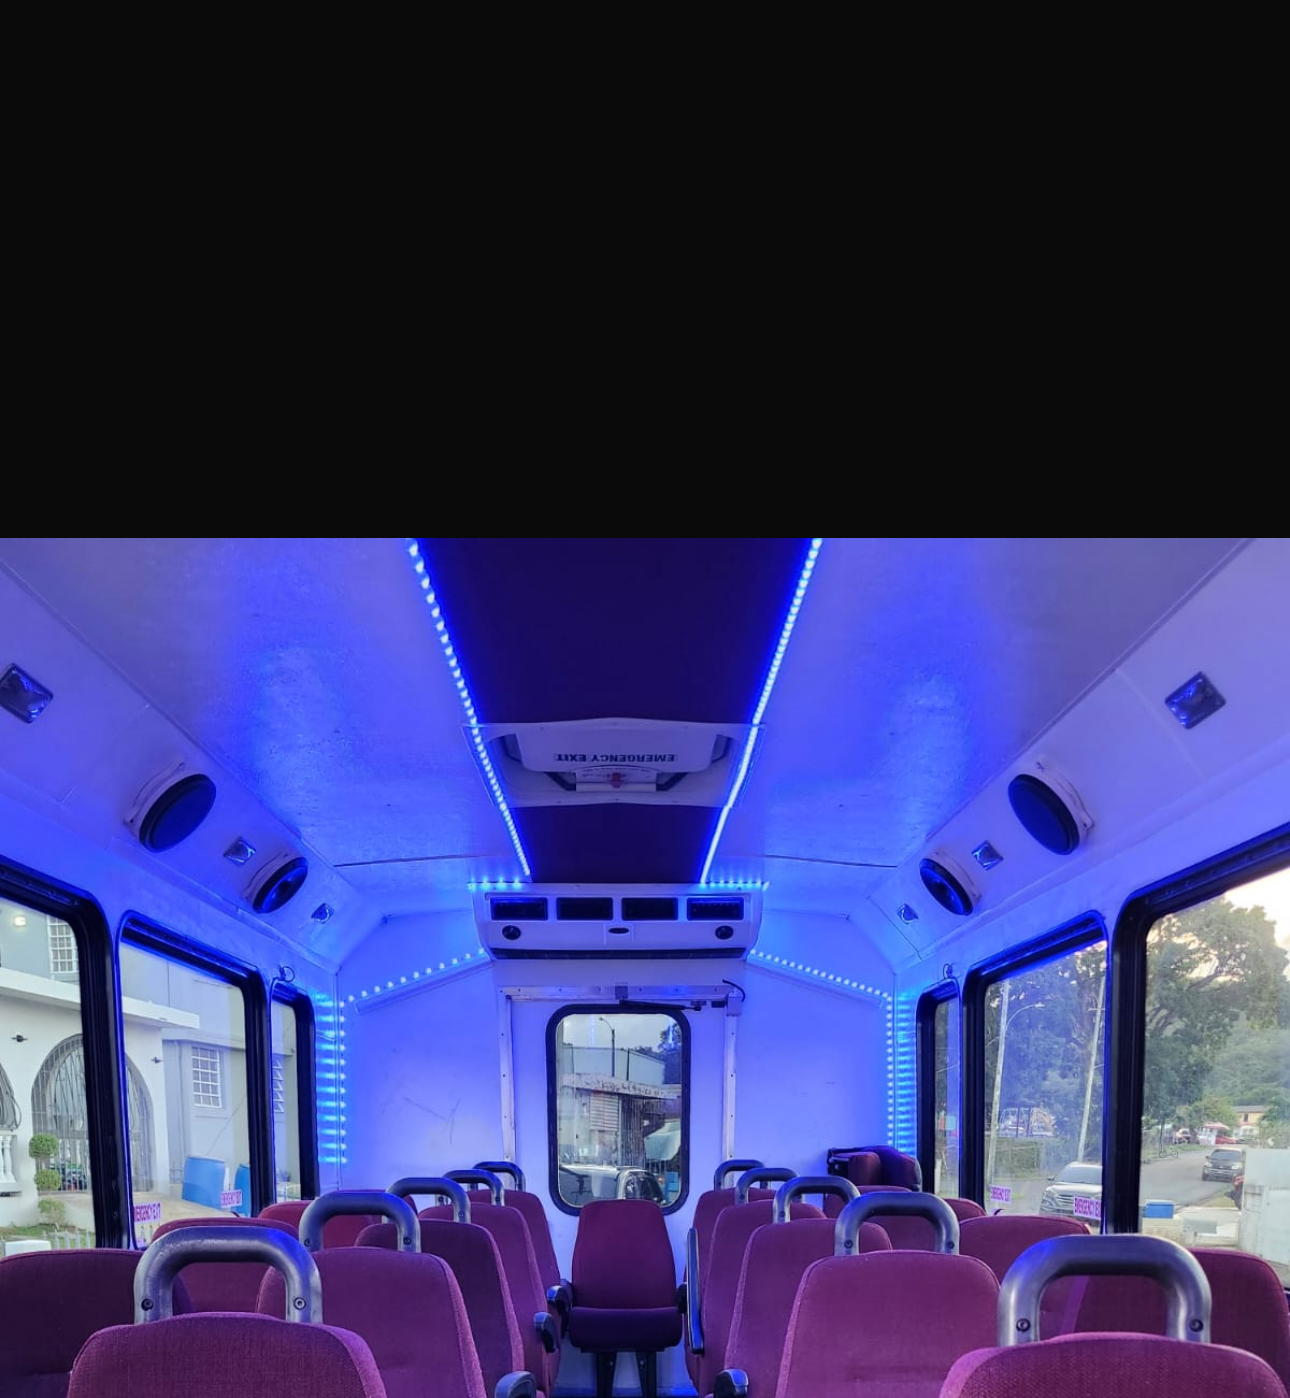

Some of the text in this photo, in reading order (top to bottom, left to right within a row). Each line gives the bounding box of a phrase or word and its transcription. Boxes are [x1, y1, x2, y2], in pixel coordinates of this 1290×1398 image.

[556, 753, 675, 763] EMERGENCY EXIT
[133, 1204, 152, 1222] MERGENCY
[1074, 1197, 1094, 1216] EMERGENCY
